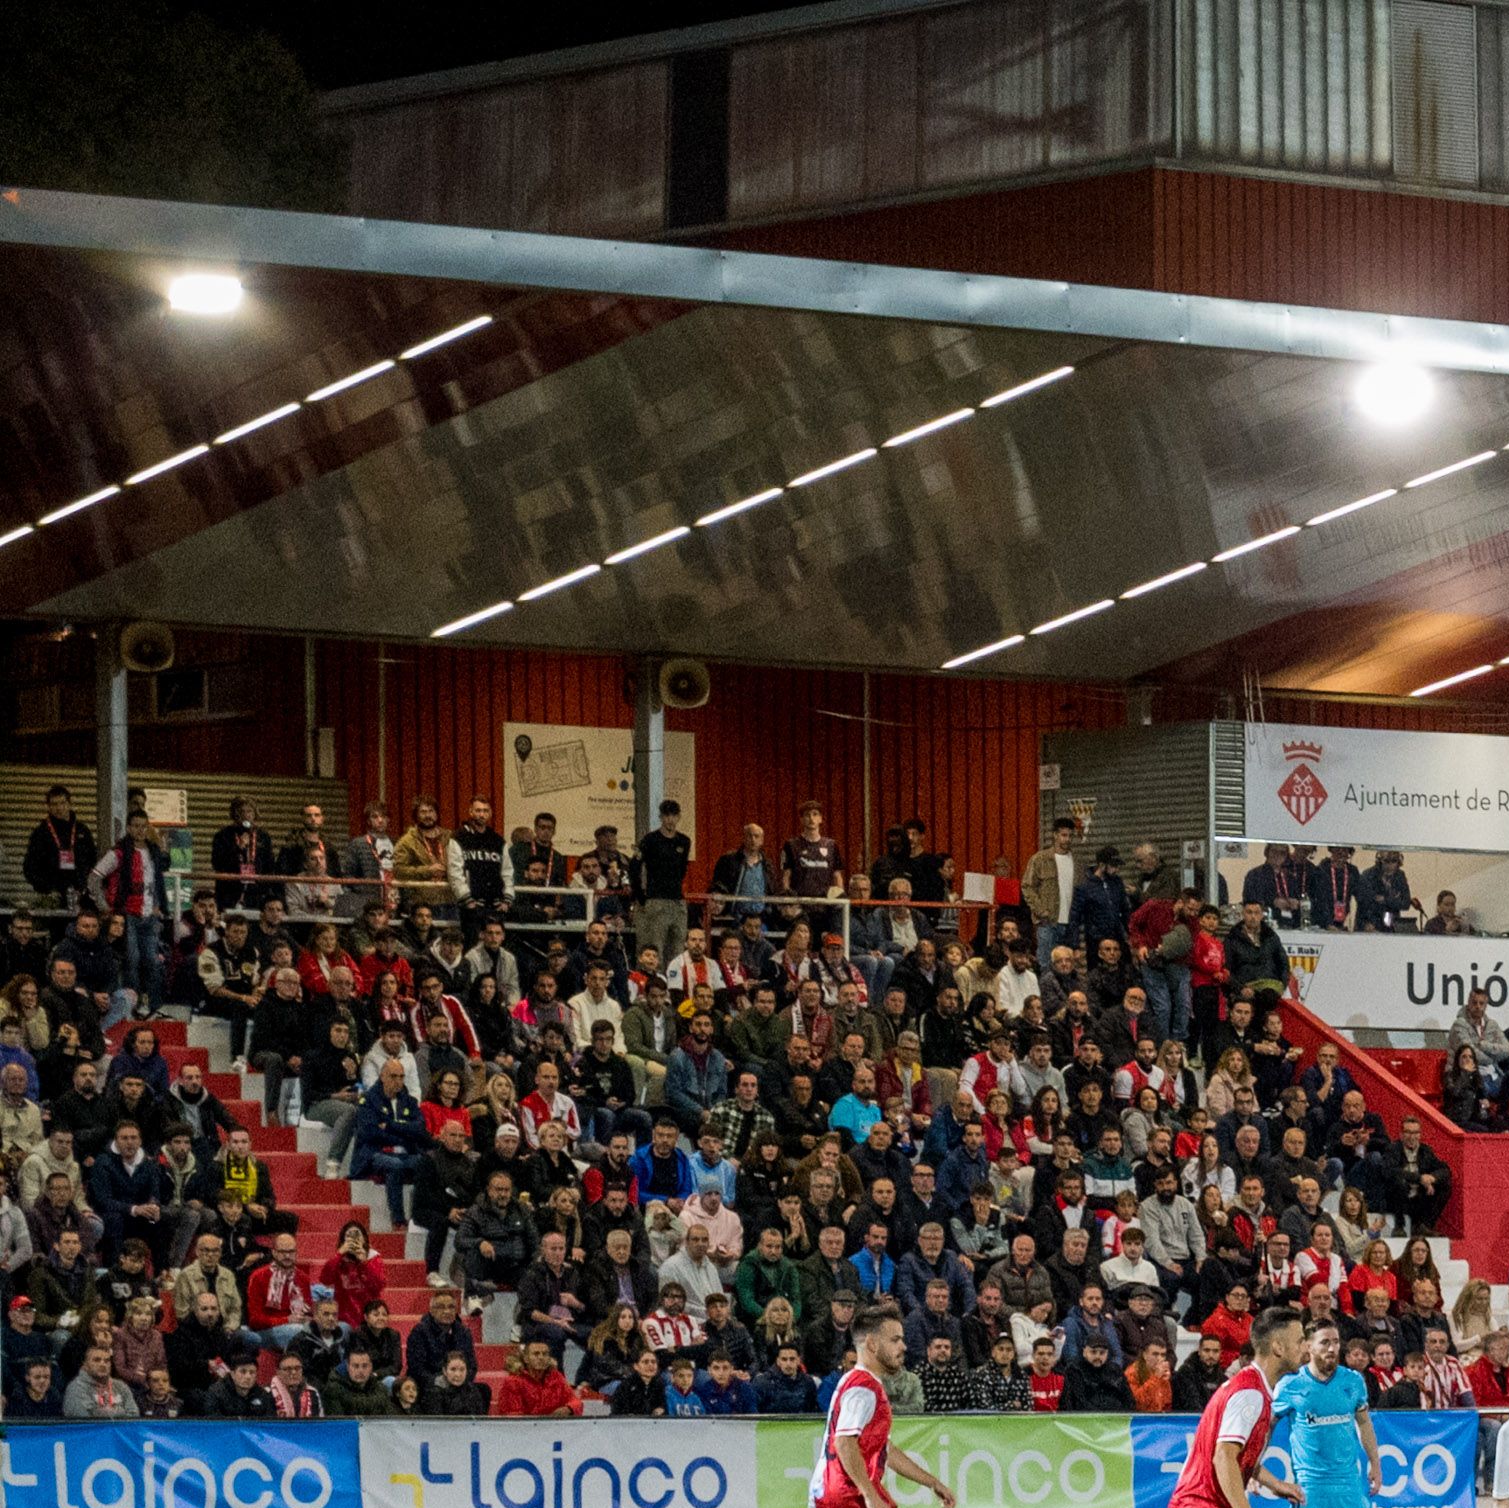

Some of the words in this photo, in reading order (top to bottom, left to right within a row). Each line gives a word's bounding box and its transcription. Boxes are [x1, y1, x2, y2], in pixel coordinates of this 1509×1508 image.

[1344, 782, 1461, 813] Ajuntament
[1467, 788, 1492, 812] de
[1407, 962, 1509, 1007] Unió
[884, 1434, 1106, 1506] ainco
